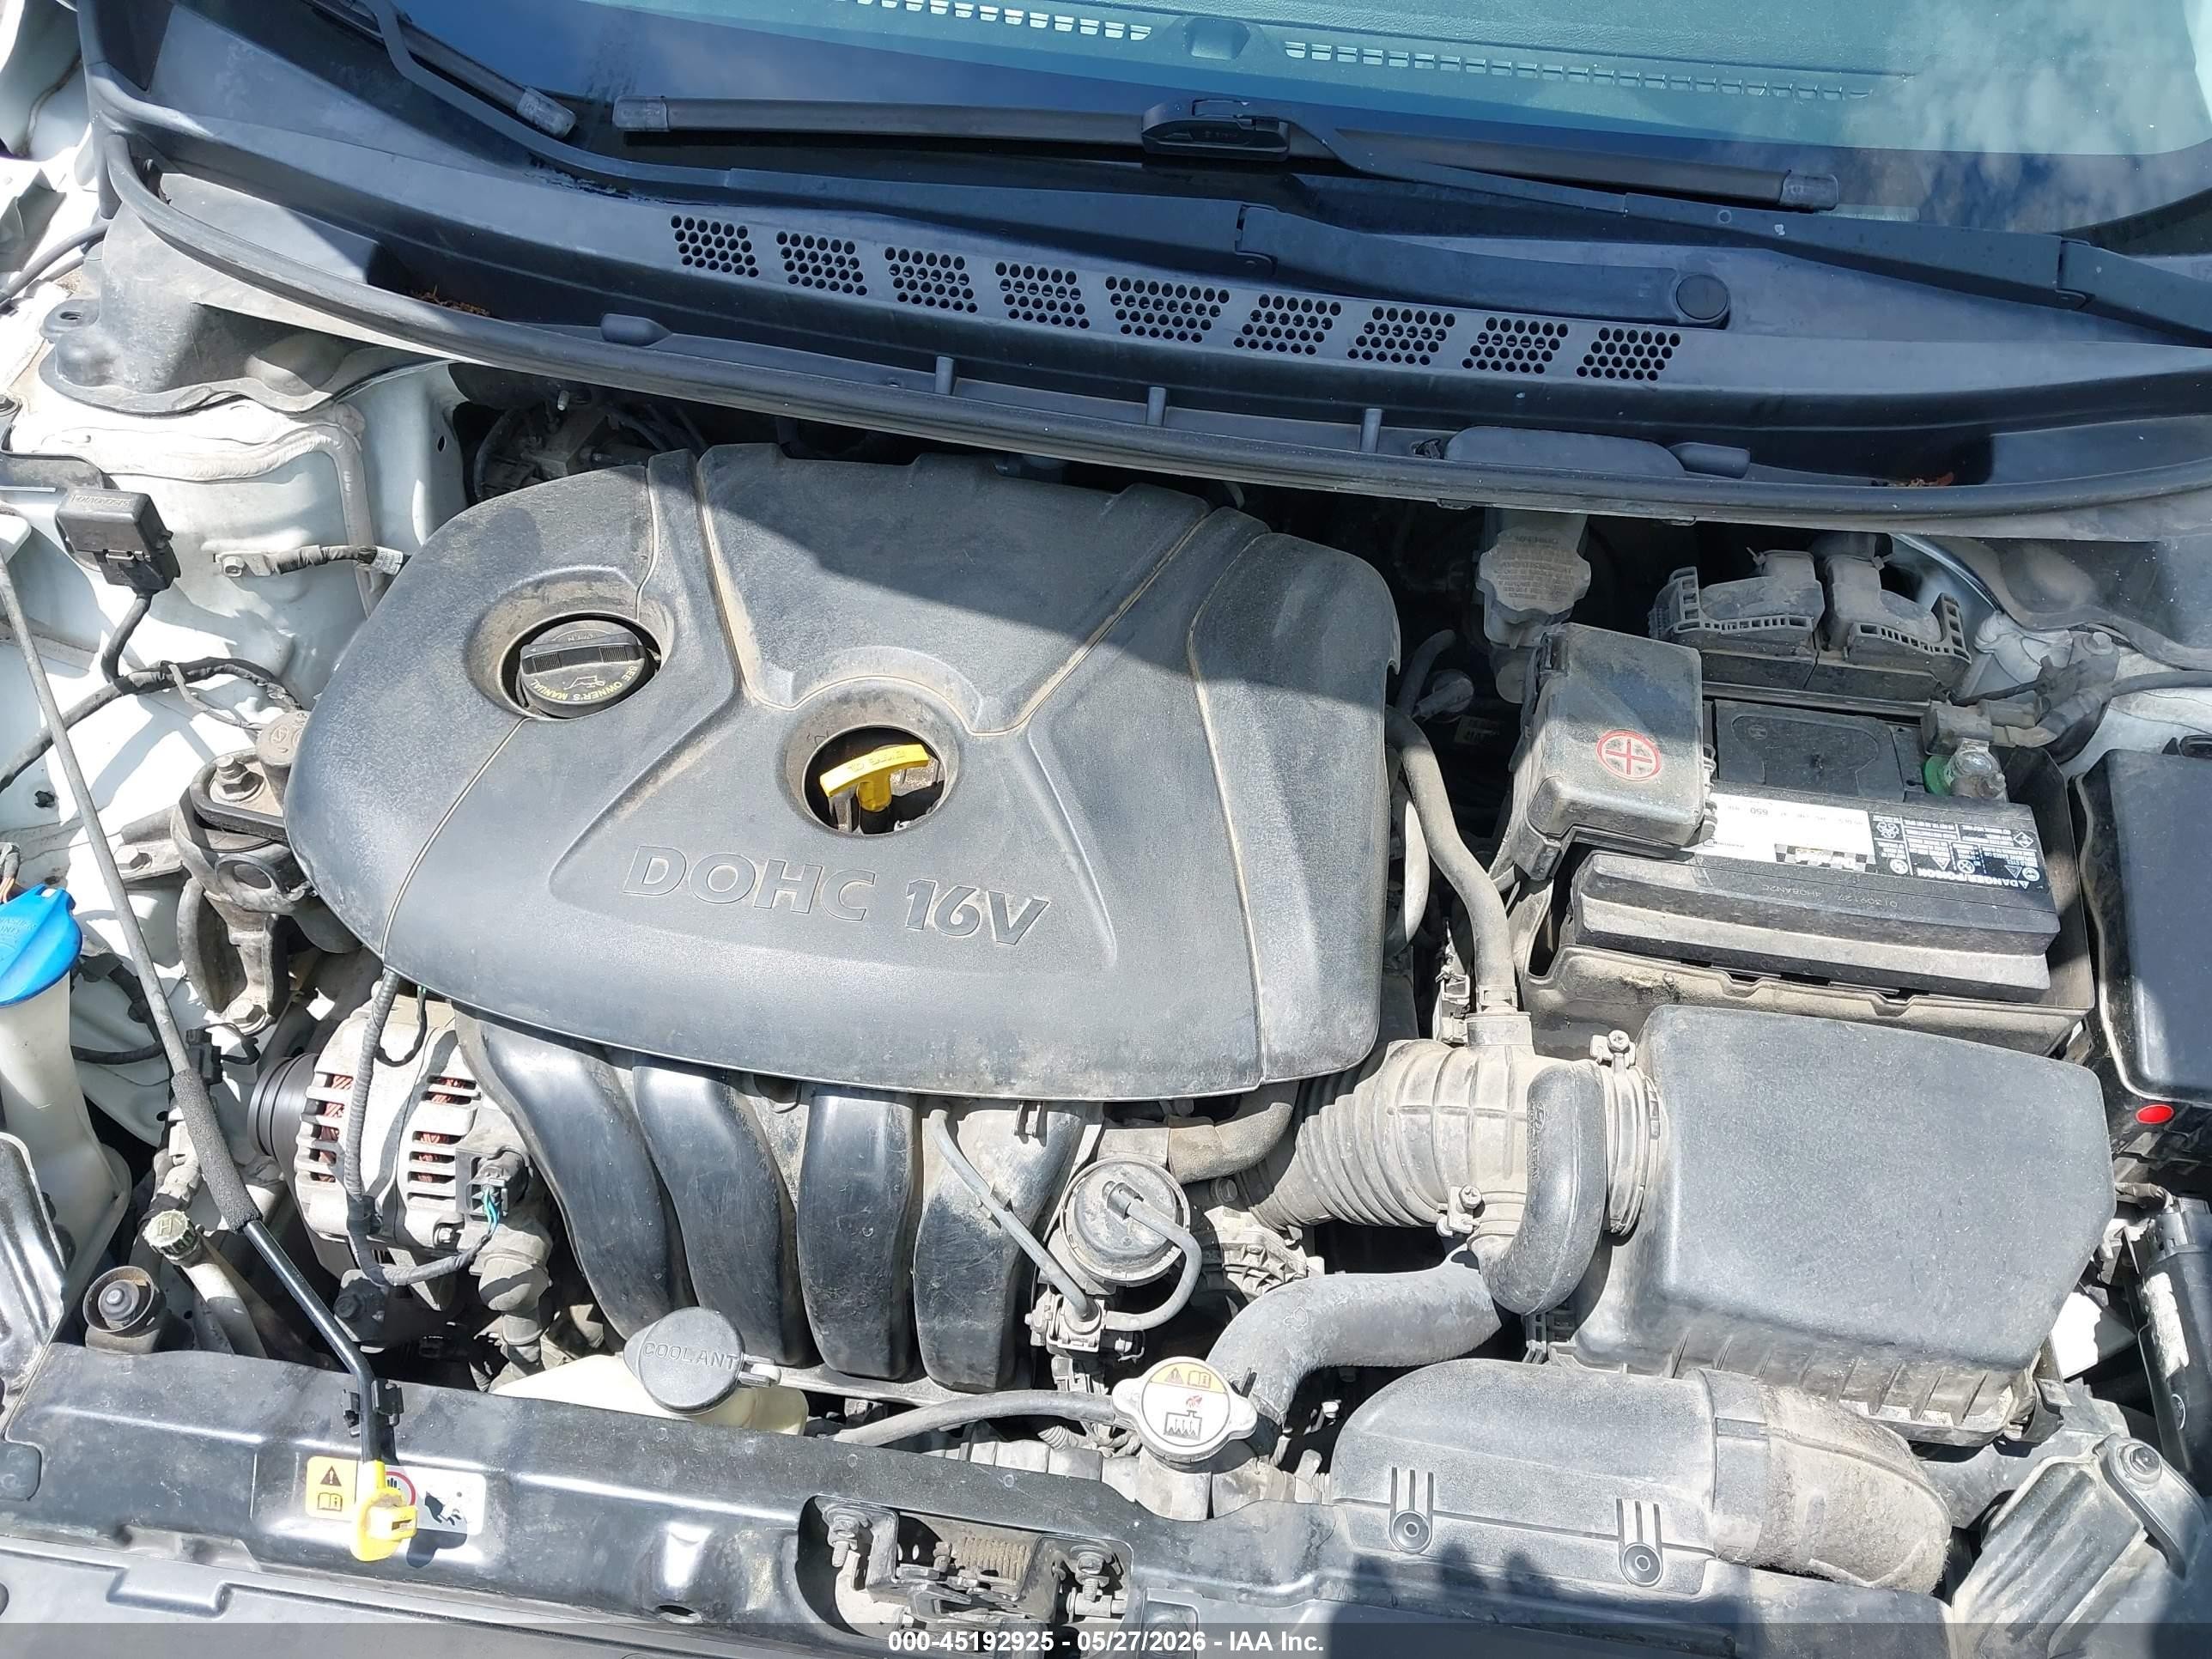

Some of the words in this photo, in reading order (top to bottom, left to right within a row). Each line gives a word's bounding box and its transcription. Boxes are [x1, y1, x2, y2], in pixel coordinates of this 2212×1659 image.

[531, 678, 568, 701] MANUAL
[573, 681, 623, 702] OWNER'S
[623, 844, 878, 922] DOHC
[904, 878, 1052, 945] 16V
[643, 1342, 738, 1370] COOLANT
